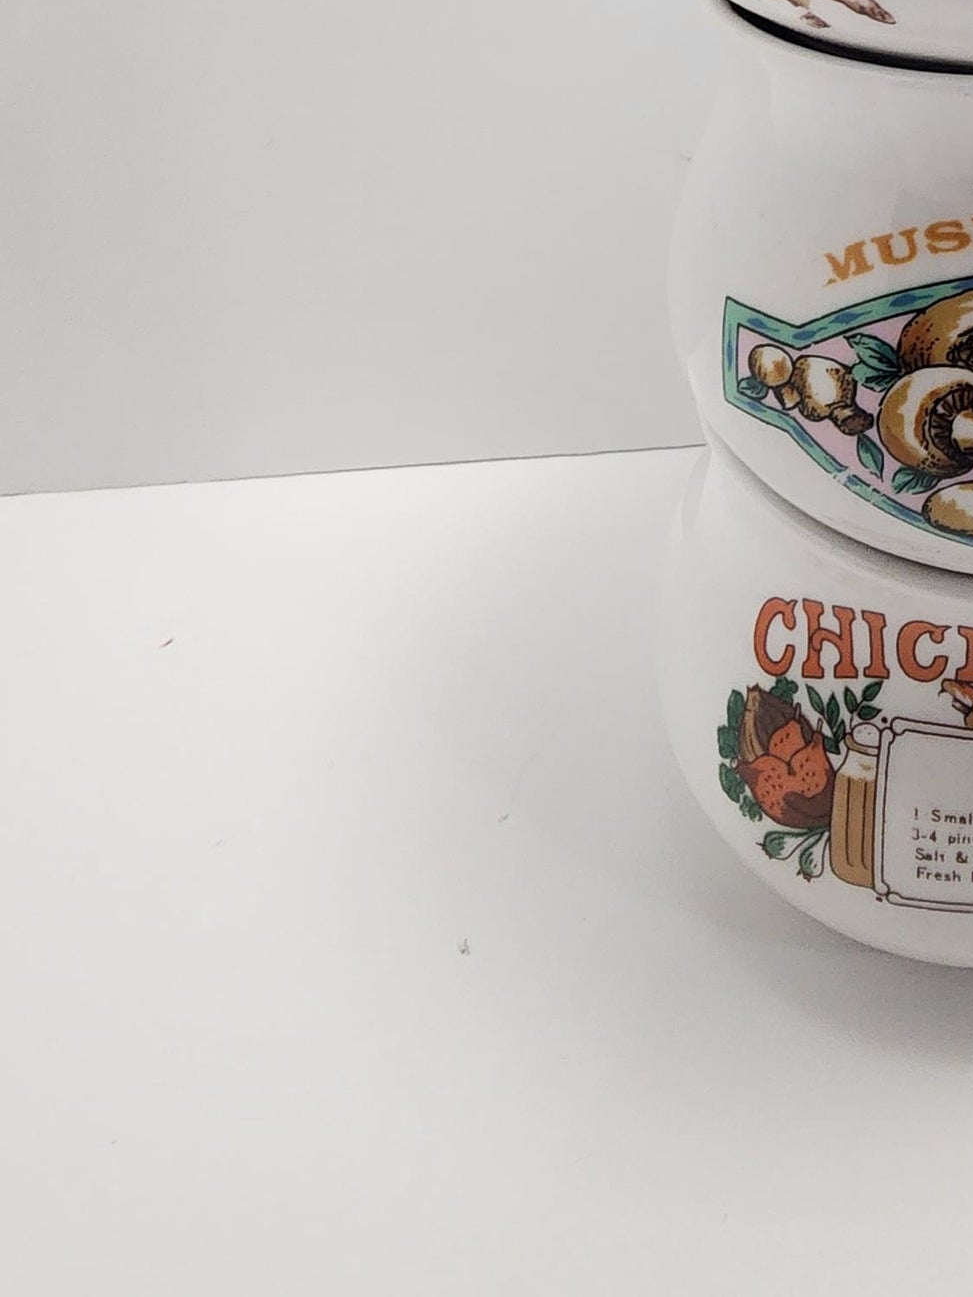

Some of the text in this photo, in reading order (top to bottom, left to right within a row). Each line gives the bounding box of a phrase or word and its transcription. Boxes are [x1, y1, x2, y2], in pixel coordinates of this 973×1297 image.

[914, 847, 946, 863] Salt
[955, 850, 970, 865] &
[915, 865, 963, 883] Fresh
